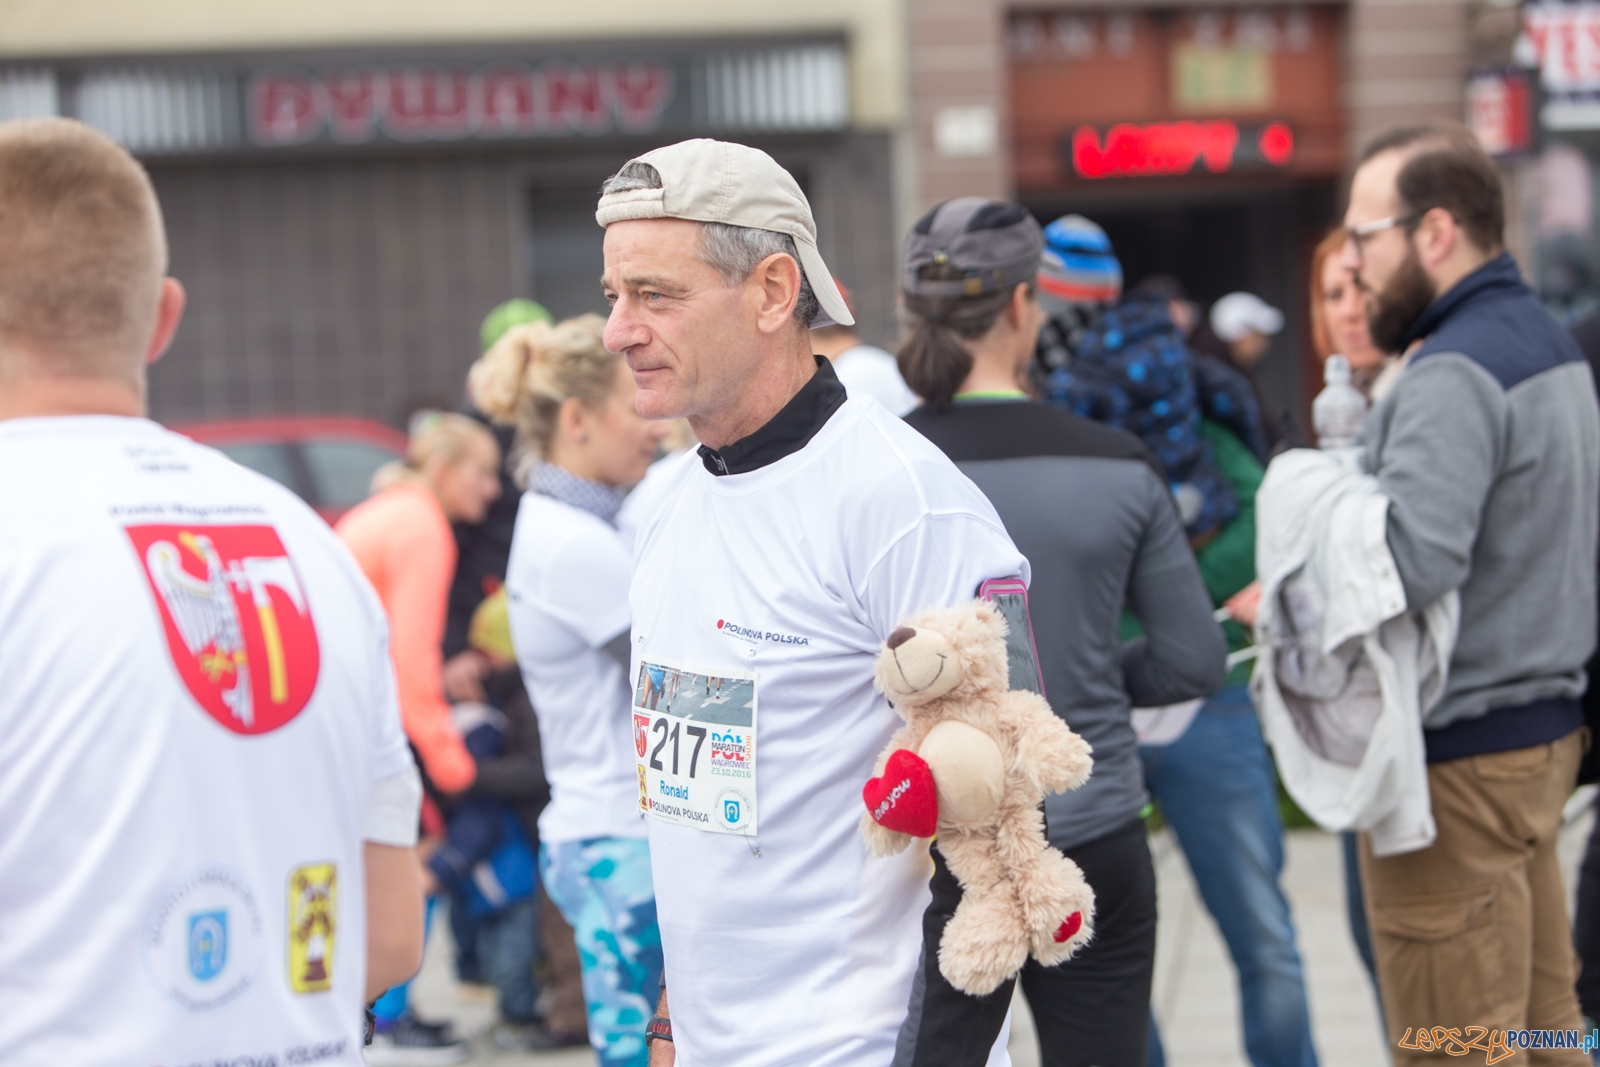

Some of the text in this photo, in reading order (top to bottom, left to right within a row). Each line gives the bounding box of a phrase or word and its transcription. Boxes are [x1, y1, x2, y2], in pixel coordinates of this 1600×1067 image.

[252, 65, 668, 142] DYWANY
[724, 622, 763, 640] POLINOVA
[765, 632, 809, 645] POLSKA
[649, 717, 707, 779] 217
[711, 742, 746, 753] MARATON
[711, 767, 752, 778] 23.10.2016
[660, 780, 689, 800] Ronald
[886, 778, 911, 808] you
[652, 800, 682, 817] POLINOVA
[682, 808, 710, 823] POLSKA
